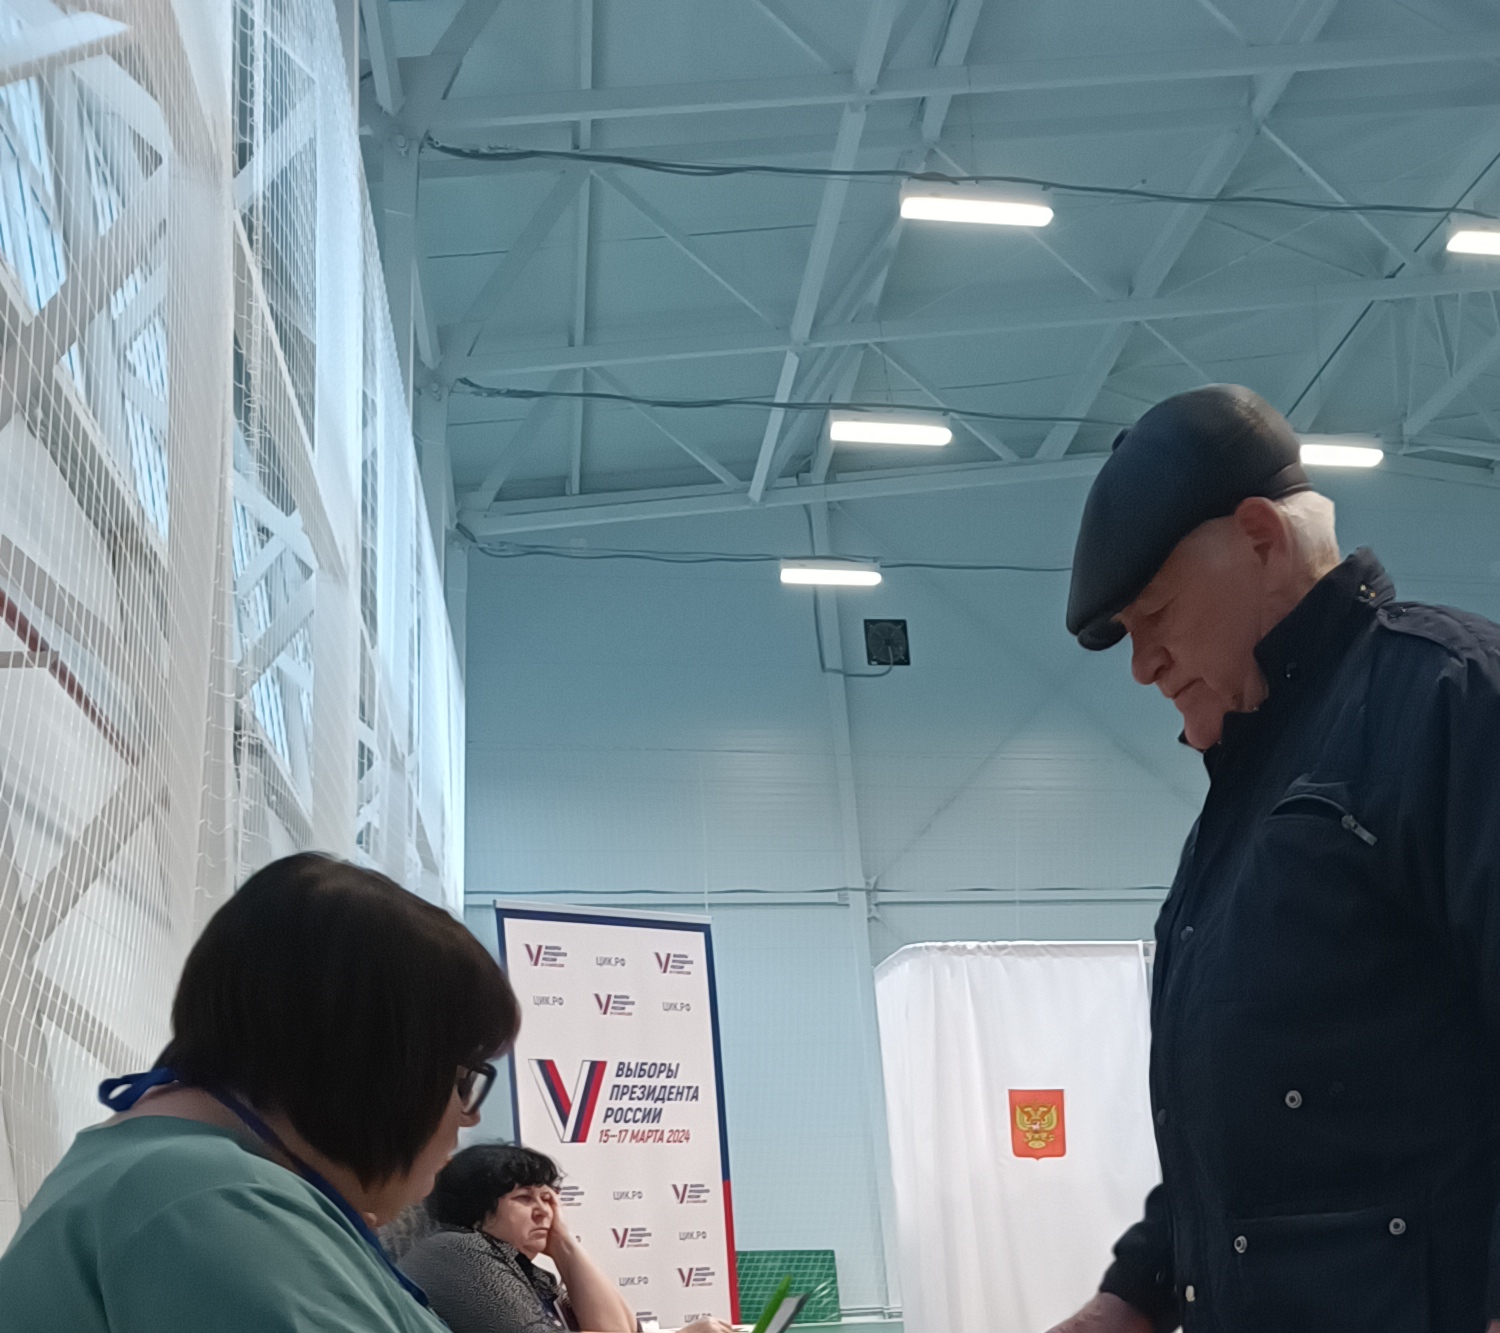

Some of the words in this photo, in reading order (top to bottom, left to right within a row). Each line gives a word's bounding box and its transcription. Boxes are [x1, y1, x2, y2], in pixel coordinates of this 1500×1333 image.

[615, 1062, 680, 1079] ВЫБОРЫ
[609, 1085, 699, 1103] ПРЕЗИДЕНТА
[603, 1107, 663, 1124] РОССИИ
[629, 1130, 664, 1144] МАРТА
[666, 1130, 690, 1144] 2024
